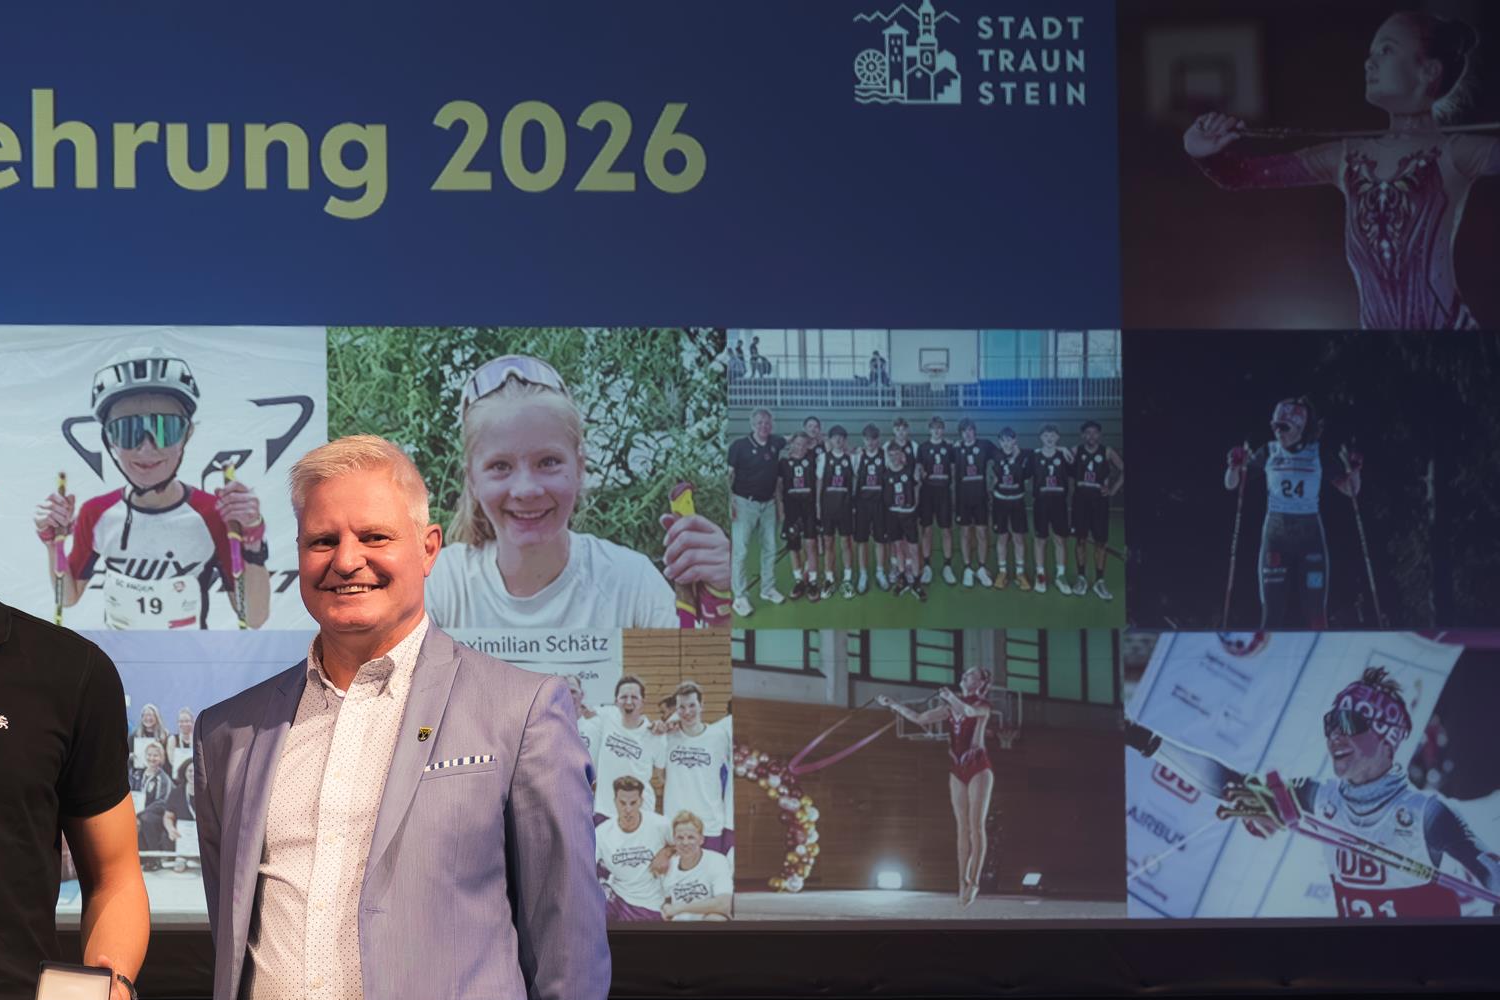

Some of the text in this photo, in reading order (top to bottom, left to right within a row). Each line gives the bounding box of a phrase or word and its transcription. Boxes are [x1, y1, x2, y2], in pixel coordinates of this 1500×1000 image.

[977, 16, 1084, 40] STADT
[978, 49, 1086, 73] TRAUN
[978, 82, 1086, 105] STEIN
[431, 100, 706, 194] 2026
[1281, 479, 1305, 498] 24
[136, 597, 163, 615] 19
[546, 634, 608, 653] Schätz
